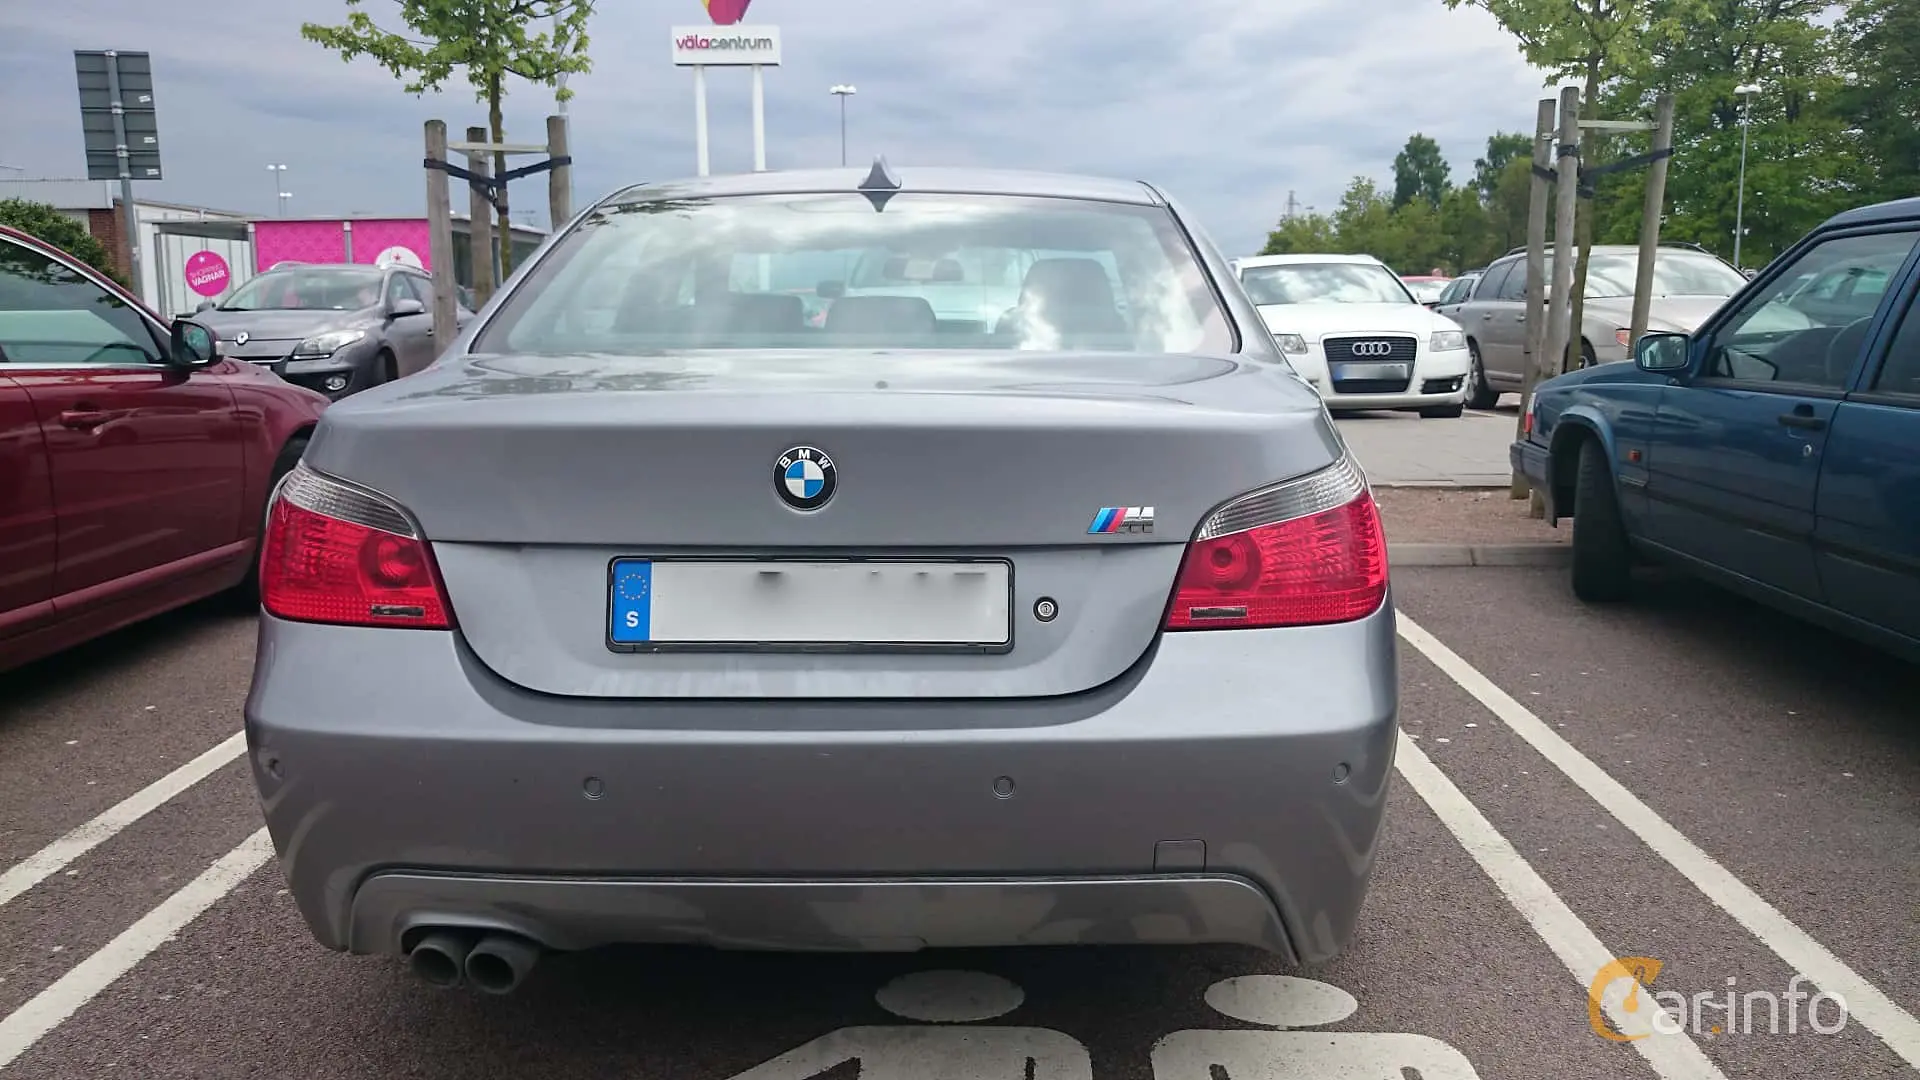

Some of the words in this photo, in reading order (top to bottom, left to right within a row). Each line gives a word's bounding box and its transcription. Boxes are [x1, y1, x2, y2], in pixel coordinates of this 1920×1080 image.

[676, 35, 772, 50] välacentrum
[191, 270, 226, 287] VAGNAR
[779, 449, 831, 469] BMW
[626, 611, 639, 628] S
